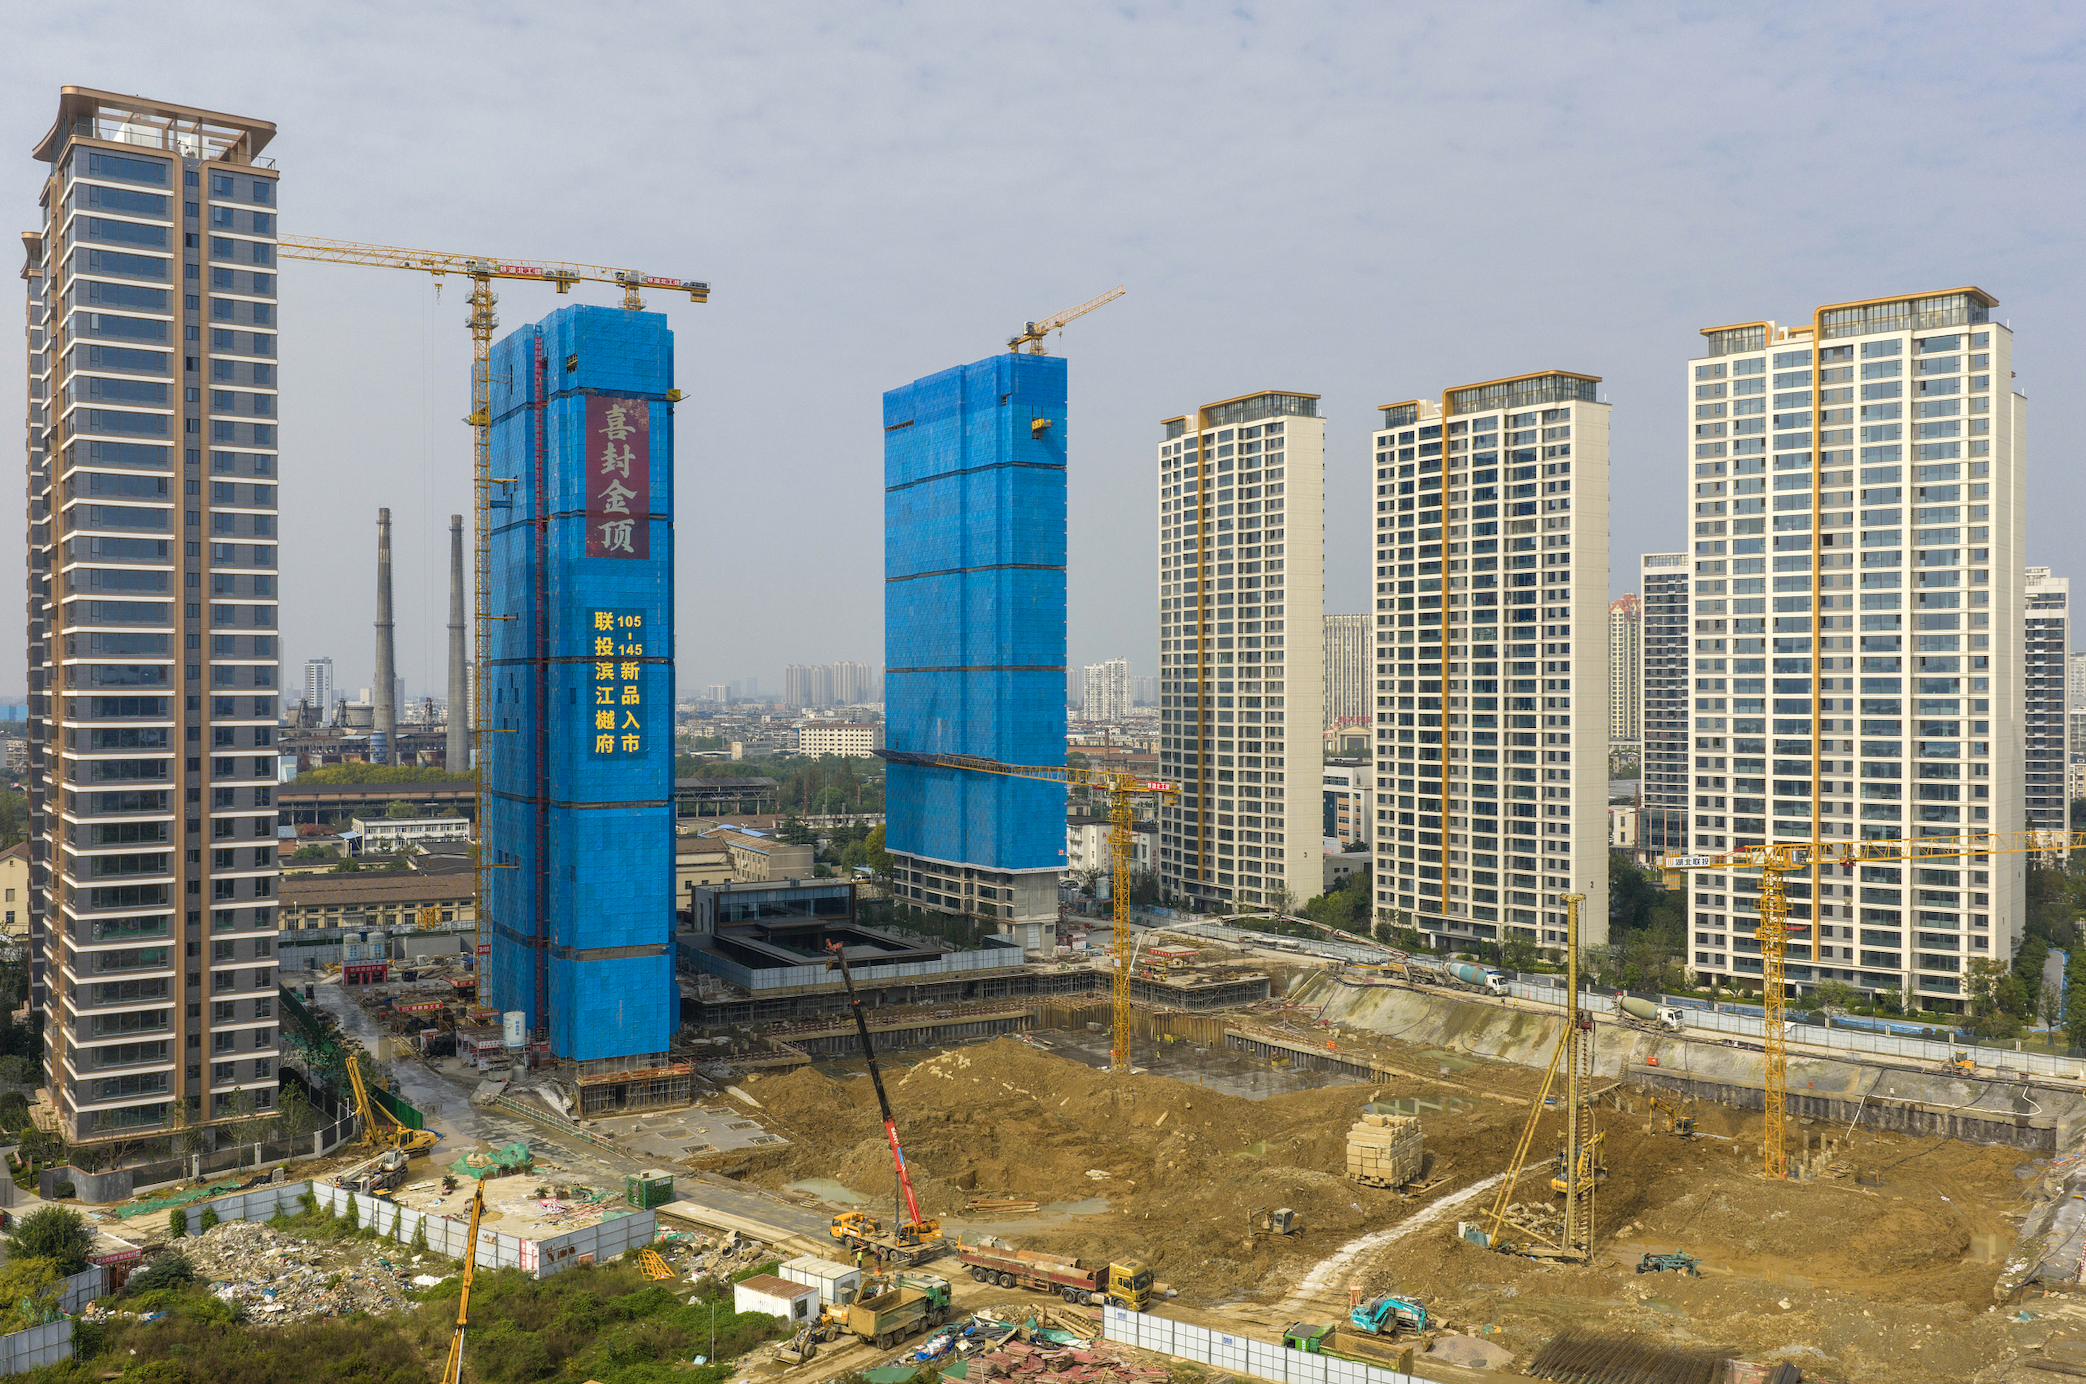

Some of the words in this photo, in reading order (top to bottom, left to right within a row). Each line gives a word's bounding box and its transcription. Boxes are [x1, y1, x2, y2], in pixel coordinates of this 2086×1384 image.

[598, 403, 638, 554] 喜封金顶
[594, 611, 616, 754] 联投滨江樾府
[890, 1126, 900, 1145] SANY
